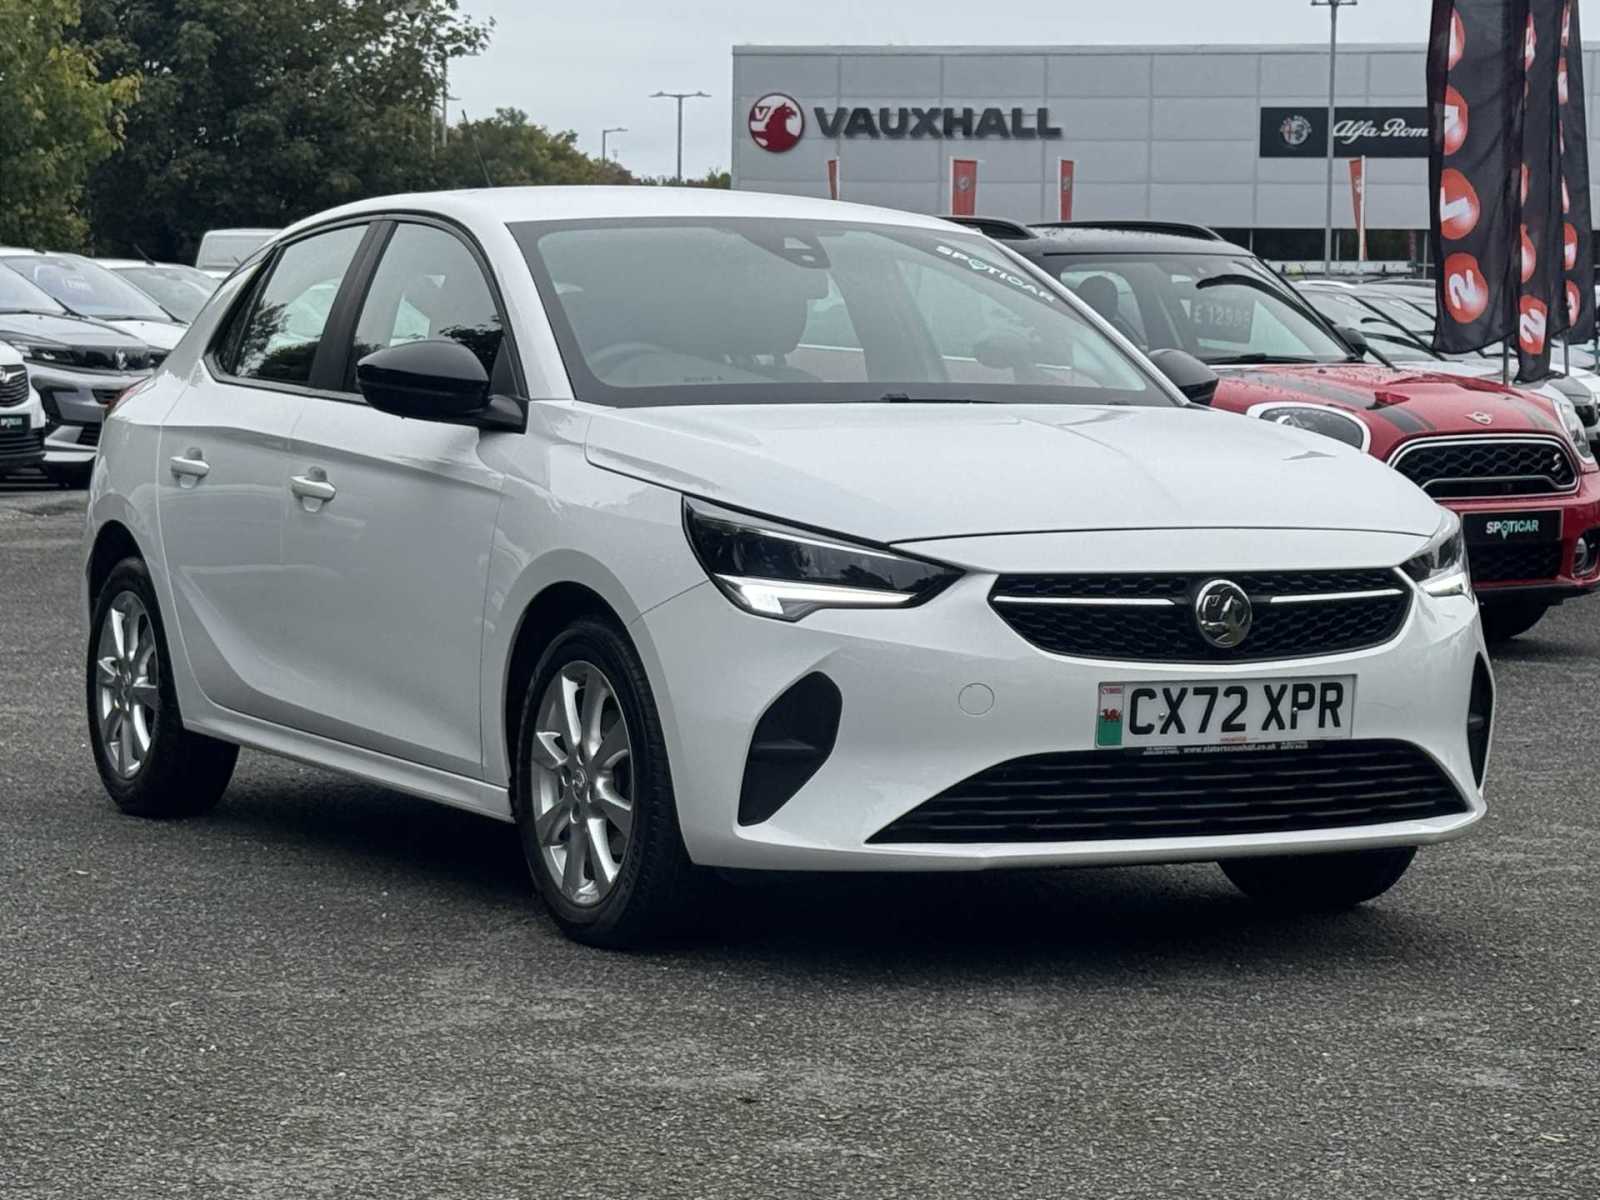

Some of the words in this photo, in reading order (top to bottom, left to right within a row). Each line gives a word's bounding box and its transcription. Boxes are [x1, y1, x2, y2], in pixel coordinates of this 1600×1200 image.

[814, 107, 1062, 138] VAUXHALL
[1333, 120, 1380, 145] Alfa
[1381, 118, 1429, 137] Rom
[936, 245, 1055, 302] SPOTICAR
[1486, 520, 1539, 539] SPOTICAR
[1129, 685, 1249, 735] CX72
[1262, 682, 1344, 731] XPR
